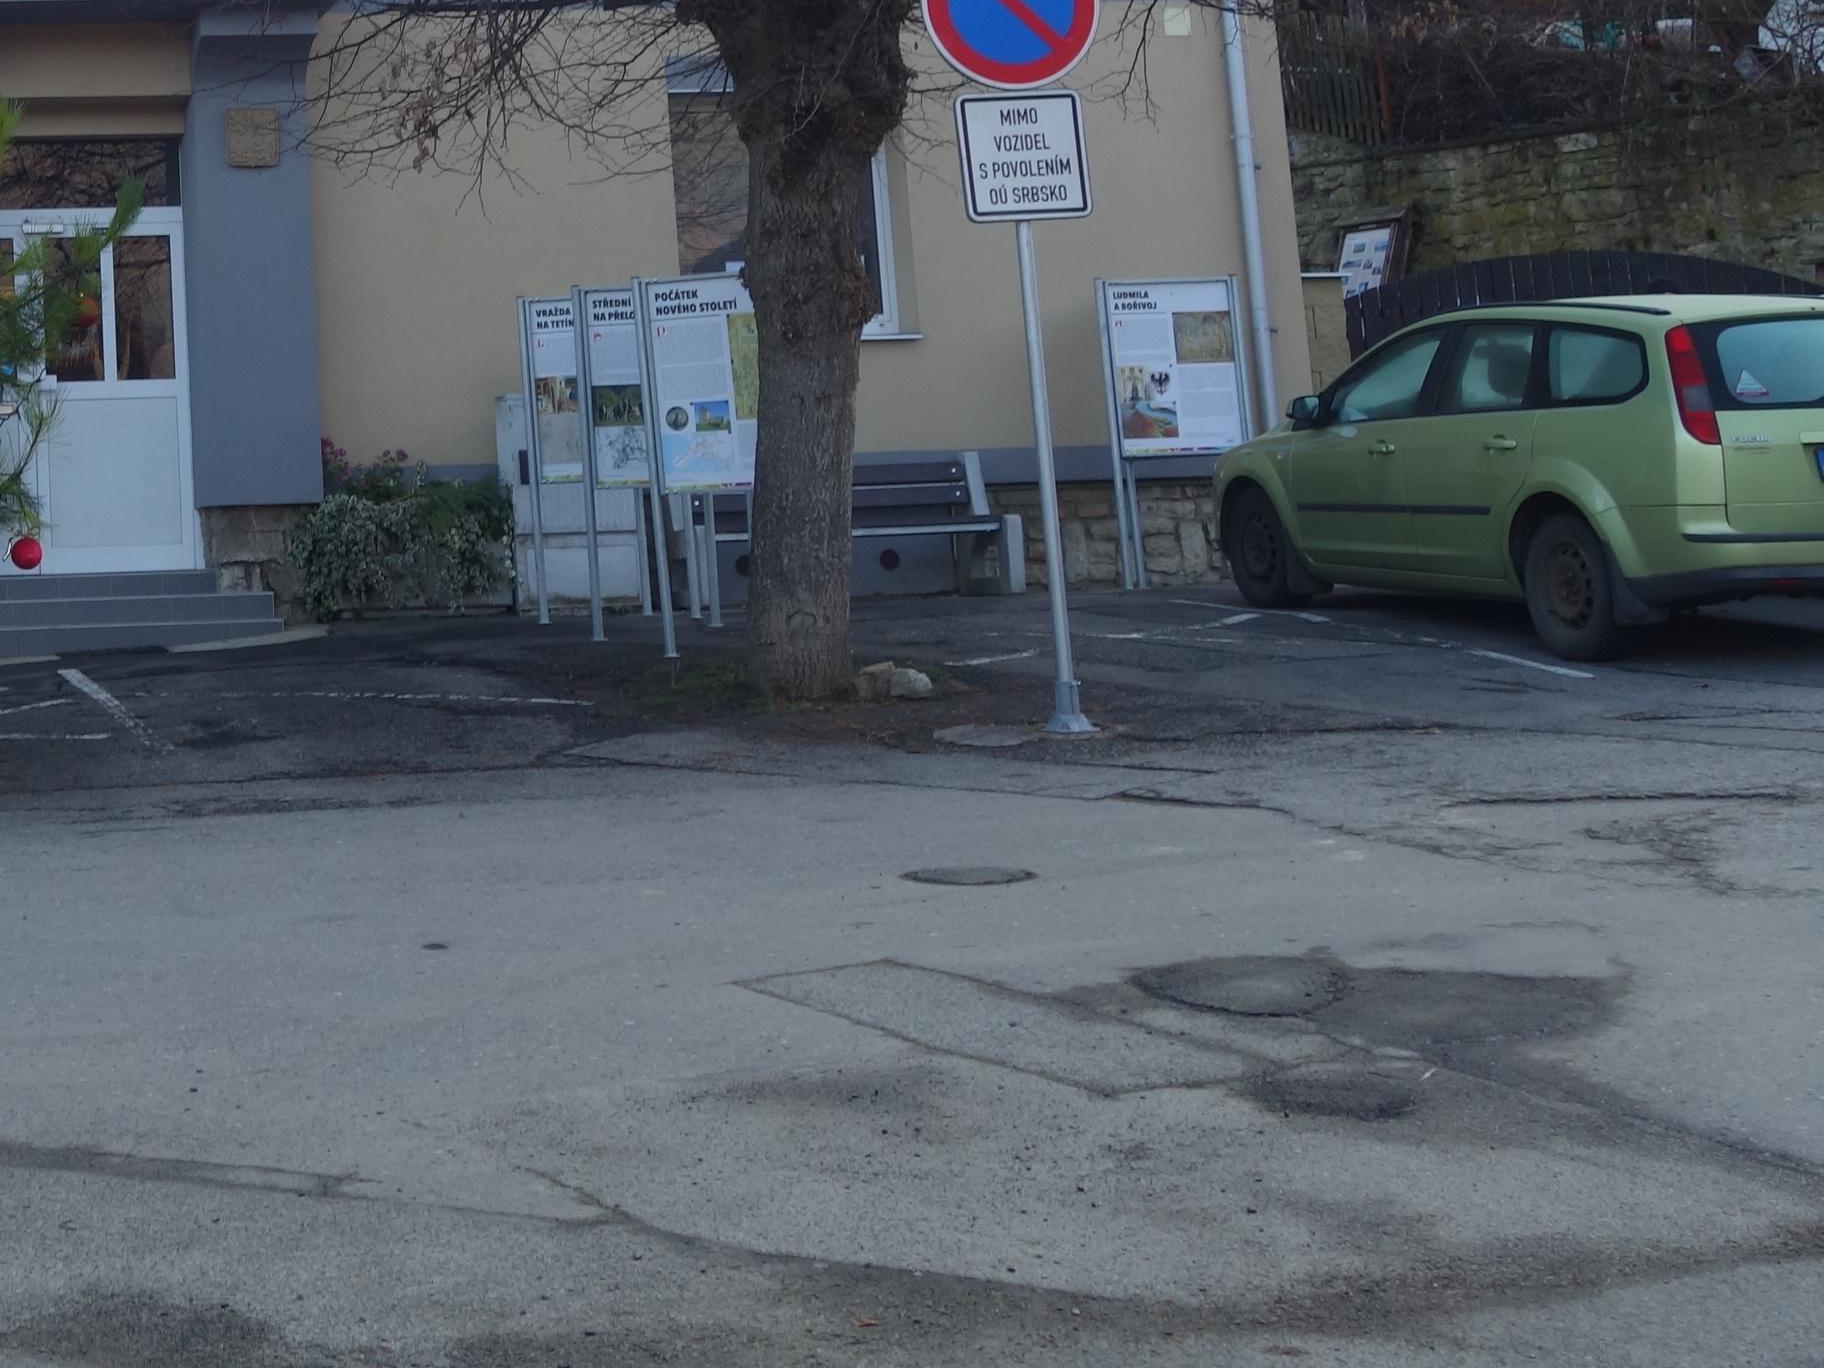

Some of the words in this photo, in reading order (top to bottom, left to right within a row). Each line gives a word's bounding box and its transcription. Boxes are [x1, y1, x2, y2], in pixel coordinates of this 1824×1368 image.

[999, 107, 1038, 126] MIMO
[993, 133, 1051, 153] VOZIDEL
[979, 163, 988, 180] S
[992, 154, 1072, 179] POVOLENÍM
[989, 184, 1008, 205] OÚ
[1012, 184, 1068, 204] SRBSKO
[654, 288, 698, 302] POČÁTEK
[1112, 290, 1150, 300] LUDMILA
[592, 296, 631, 309] STŘEDNÍ
[656, 302, 697, 316] NOVÉHO
[699, 297, 737, 312] STOLETÍ
[1113, 302, 1120, 311] A
[1121, 300, 1158, 311] BOŘIVOJ
[536, 307, 571, 318] VRAŽDA
[593, 312, 606, 322] NA
[537, 320, 549, 330] NA
